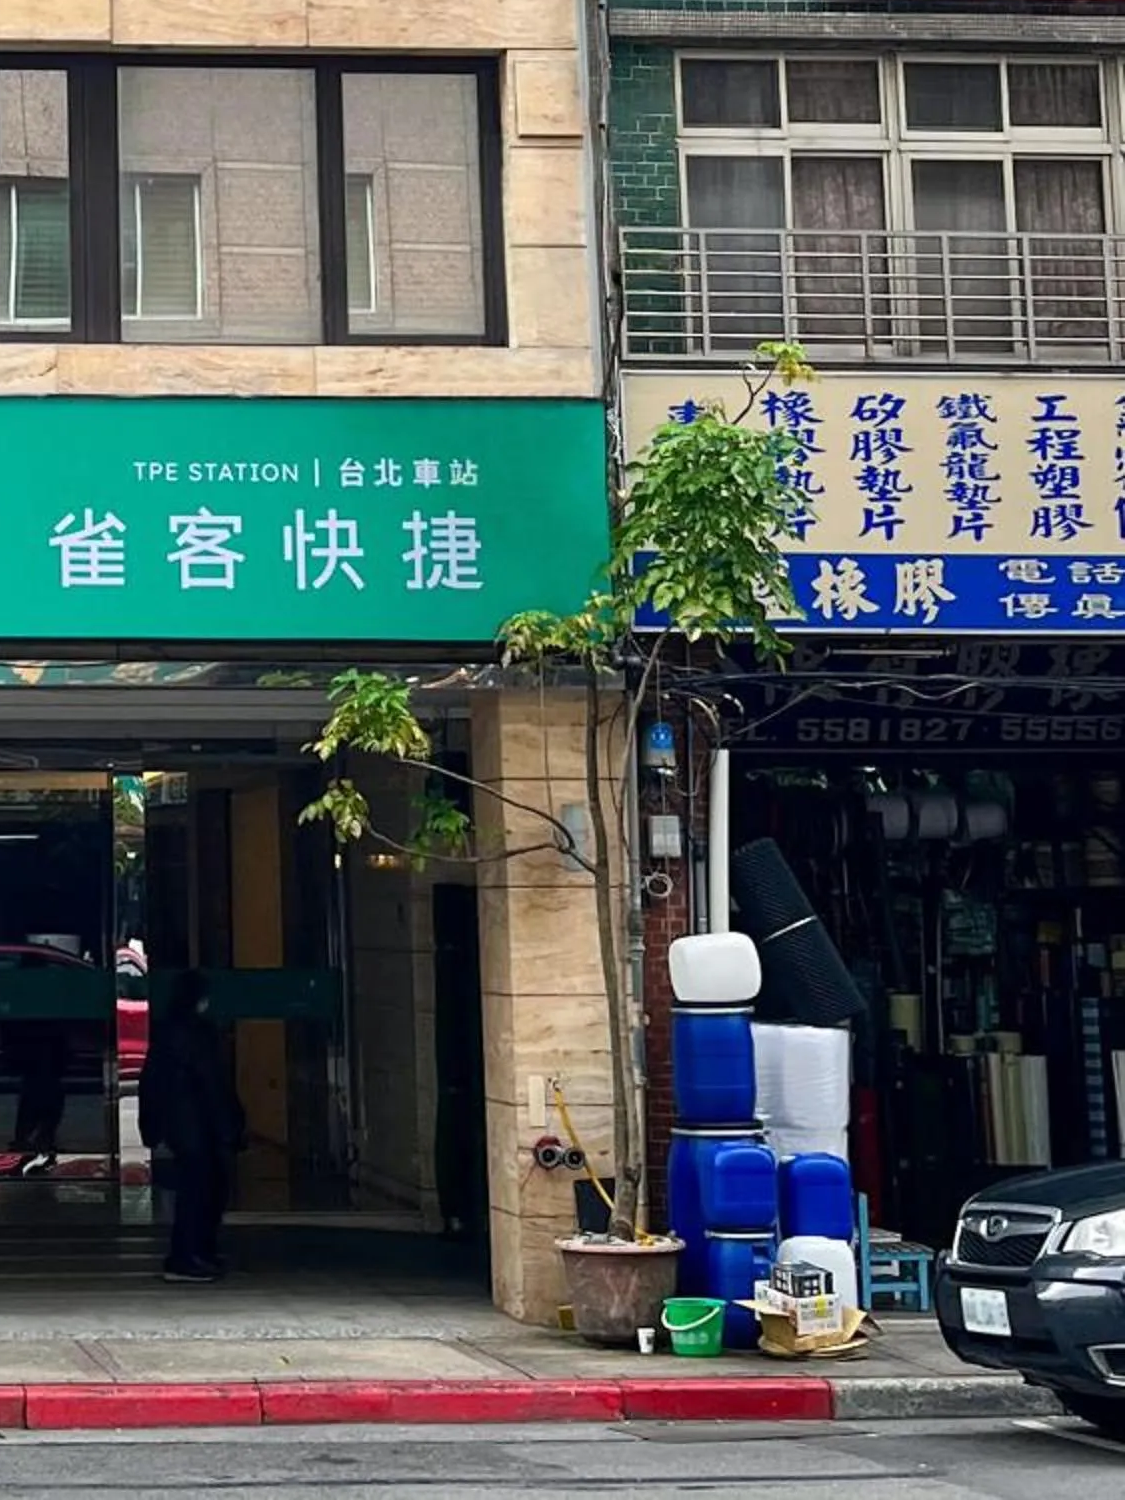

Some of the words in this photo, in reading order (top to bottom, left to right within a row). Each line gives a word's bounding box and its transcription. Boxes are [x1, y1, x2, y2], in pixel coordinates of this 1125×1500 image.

[133, 461, 178, 482] TPE
[188, 461, 299, 483] STATION
[338, 457, 480, 489] 台北車站
[849, 393, 915, 542] 矽膠墊片
[1026, 394, 1095, 542] 工程塑膠
[49, 506, 484, 592] 雀客快捷
[998, 558, 1125, 585] 電話
[796, 718, 974, 742] 5581827
